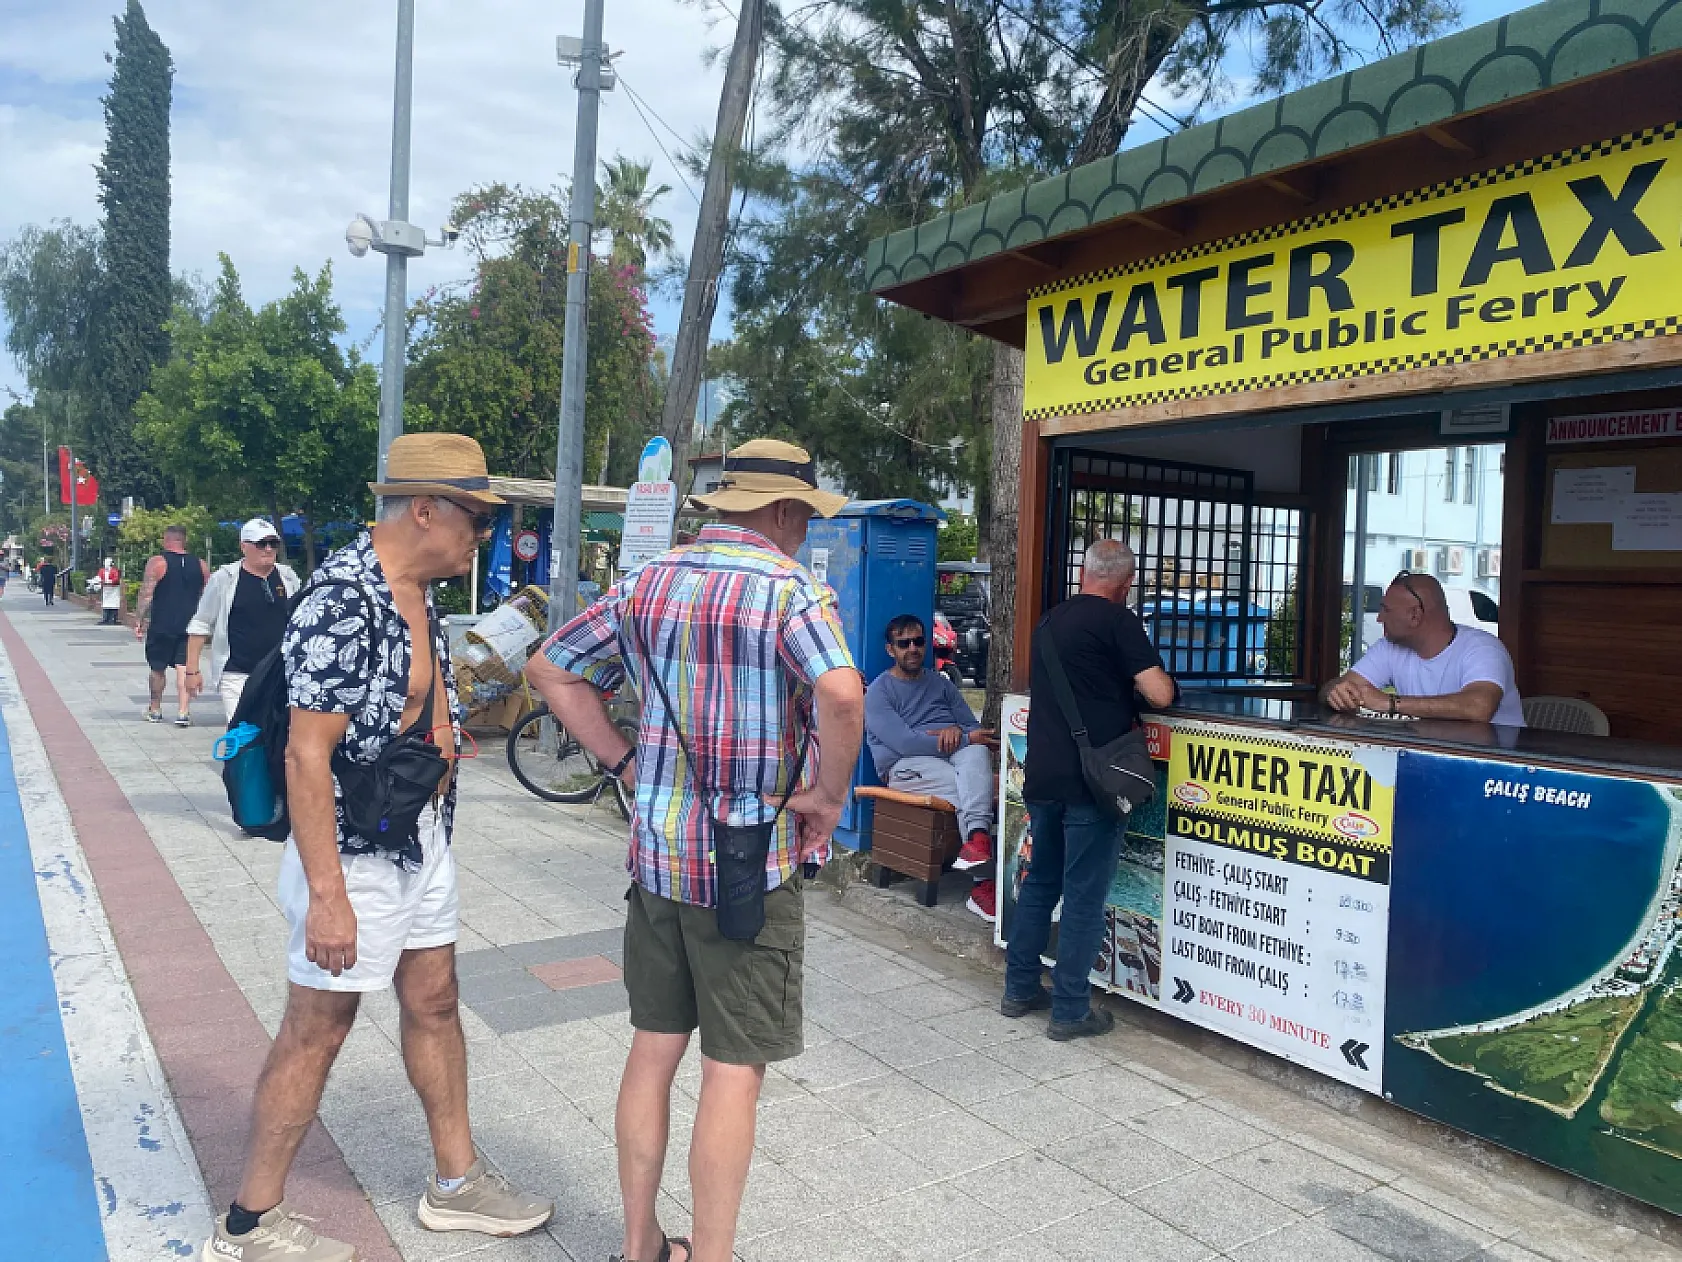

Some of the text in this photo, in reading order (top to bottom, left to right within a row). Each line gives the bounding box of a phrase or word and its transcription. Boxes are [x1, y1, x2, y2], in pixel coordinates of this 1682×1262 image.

[1038, 158, 1682, 365] WATER TAX
[1083, 275, 1627, 386] General Public Ferry
[1549, 411, 1671, 441] ANNOUNCEMENT
[1186, 742, 1372, 811] WATER TAXI
[1484, 778, 1592, 809] ÇALIŞ BEACH
[1216, 790, 1330, 828] General Public Ferry
[1175, 851, 1215, 877] FETHİYE
[1223, 863, 1252, 890] ÇALIŞ
[1254, 869, 1289, 896] START
[1177, 816, 1375, 877] DOLMUŞ BOAT
[1173, 880, 1201, 907] ÇALIŞ
[1209, 888, 1250, 917] FETHİYE
[1253, 901, 1287, 927] START
[1173, 908, 1196, 931] LAST
[1198, 915, 1223, 940] BOAT
[1226, 923, 1257, 950] FROM
[1260, 937, 1304, 965] FETHİYE
[1171, 936, 1195, 961] LAST
[1197, 945, 1223, 970] BOAT
[1225, 953, 1256, 979] FROM
[1258, 965, 1289, 996] ÇALIŞ
[1200, 990, 1244, 1017] EVERY
[1248, 1003, 1267, 1025] 30
[1269, 1014, 1331, 1049] MINUTE
